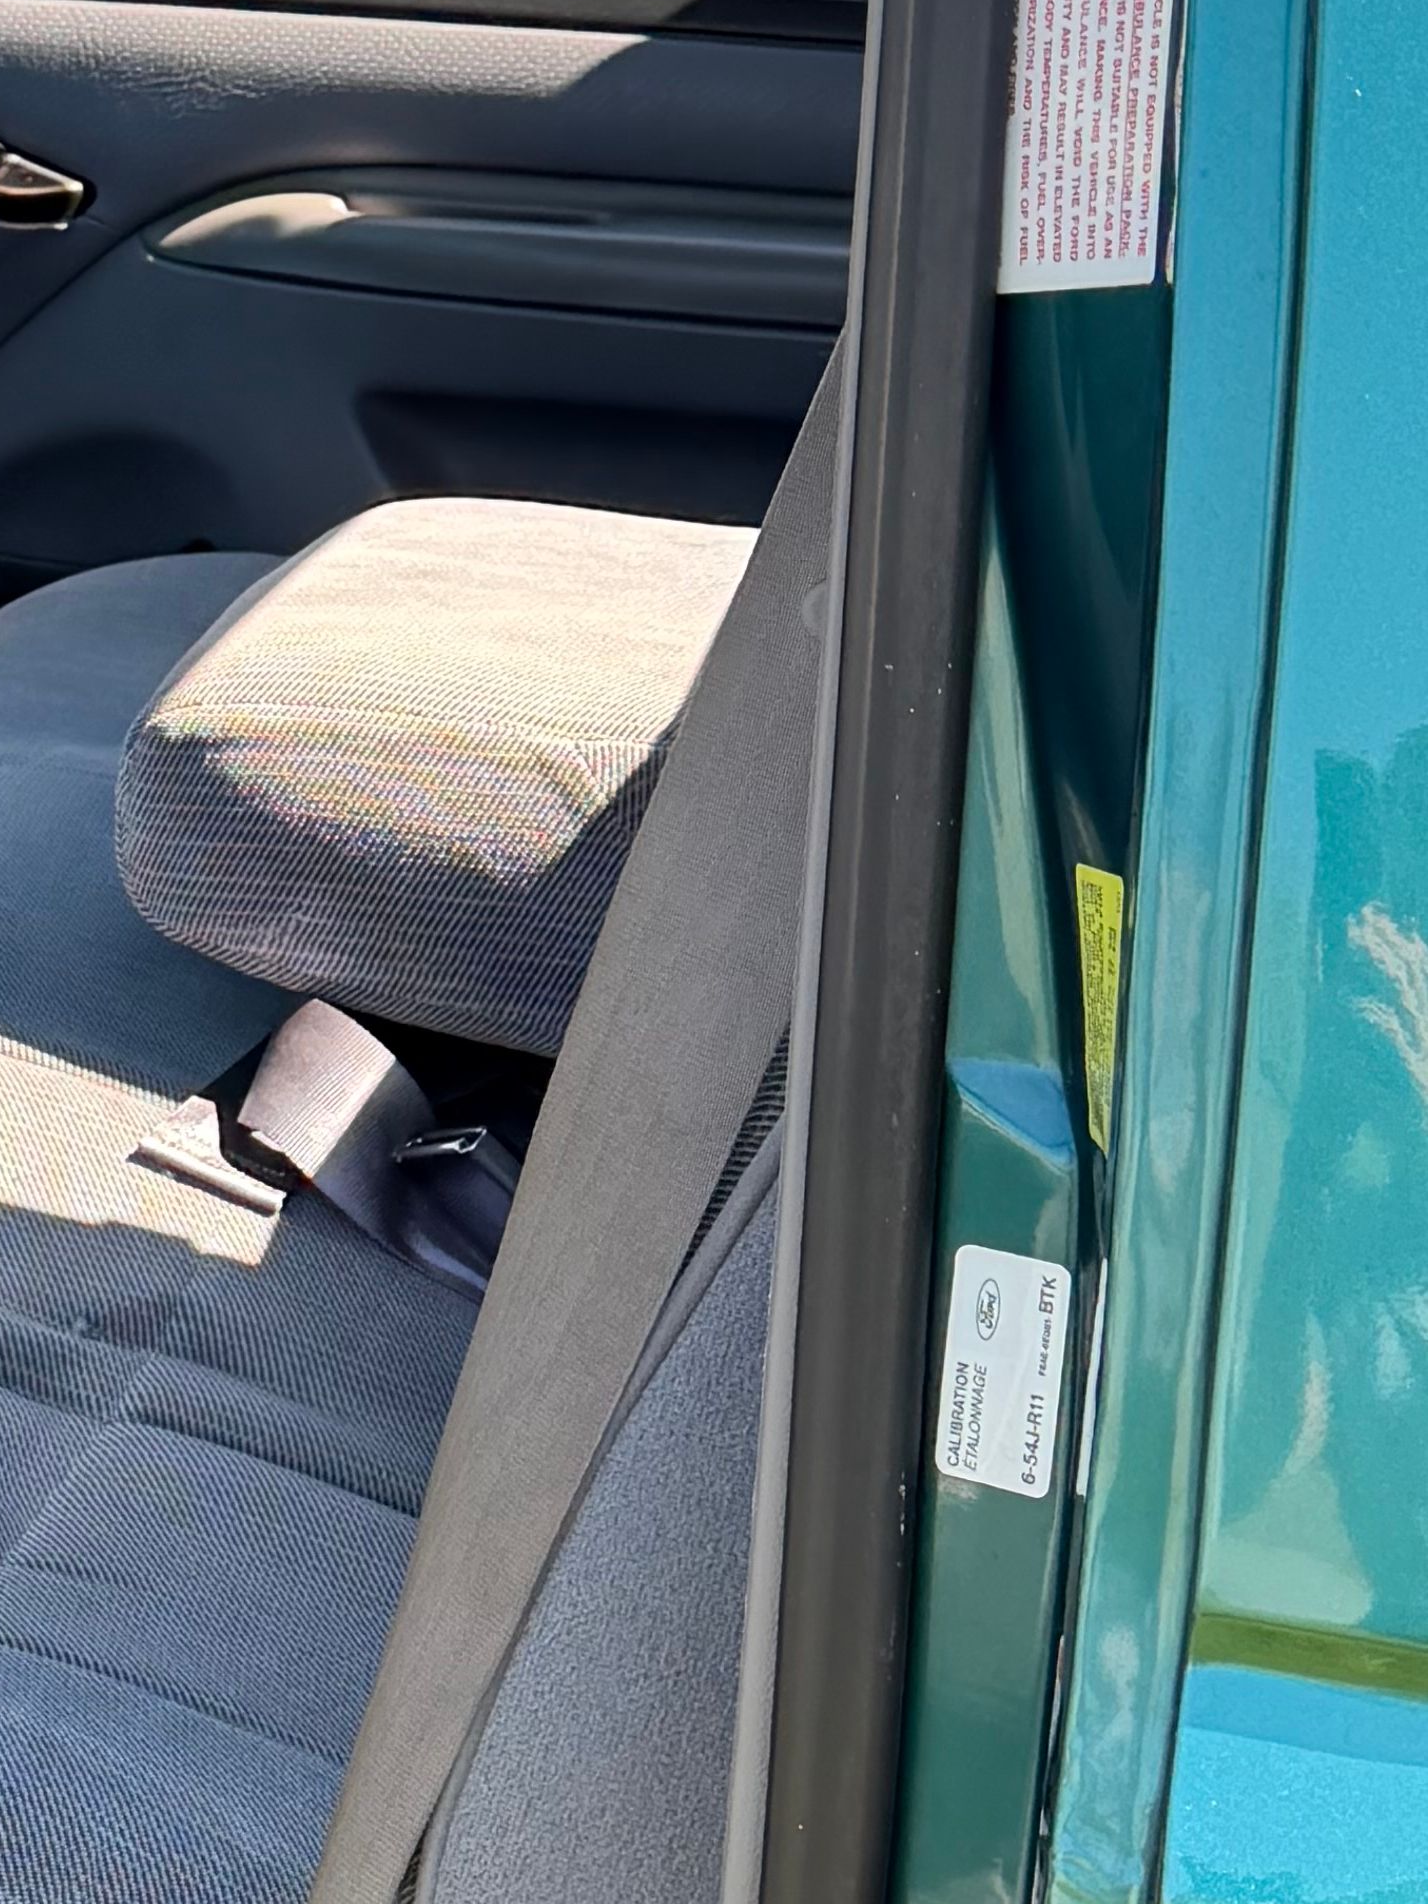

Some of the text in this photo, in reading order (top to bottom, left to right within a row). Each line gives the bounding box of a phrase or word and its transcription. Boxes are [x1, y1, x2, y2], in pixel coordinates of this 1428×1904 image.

[1117, 1, 1126, 15] IS
[1061, 27, 1071, 59] AND
[1114, 21, 1125, 52] NOT
[1151, 34, 1160, 49] IS
[1059, 64, 1068, 95] MAY
[1093, 39, 1106, 102] MAKING
[1148, 55, 1158, 88] NOT
[1023, 78, 1032, 110] AND
[1074, 78, 1087, 119] WILL
[1109, 59, 1121, 134] SUITABLE
[1022, 118, 1031, 148] THE
[1055, 102, 1066, 161] RESULT
[1091, 109, 1102, 143] THIS
[1142, 94, 1156, 173] EQUIPPED
[1073, 127, 1083, 167] VOID
[1108, 139, 1118, 170] FOR
[1123, 88, 1139, 201] PREPARATION
[1021, 155, 1029, 190] RISK
[1055, 166, 1063, 180] IN
[1088, 151, 1099, 217] VEHICLE
[1037, 172, 1047, 211] FUEL
[1072, 176, 1081, 208] THE
[1106, 175, 1115, 206] USE
[1139, 180, 1150, 220] WITH
[1020, 198, 1029, 219] OF
[1053, 186, 1062, 263] ELEVATED
[1105, 211, 1114, 232] AS
[1019, 227, 1029, 266] FUEL
[1070, 216, 1079, 262] FORD
[1087, 224, 1096, 260] INTO
[1104, 237, 1113, 259] AN
[1138, 227, 1148, 257] THE
[1022, 1394, 1044, 1485] 6-54J-R11
[1039, 1274, 1056, 1314] BTK
[947, 1362, 969, 1467] CALIBRATION
[964, 1363, 987, 1471] ÉTALONNAGE
